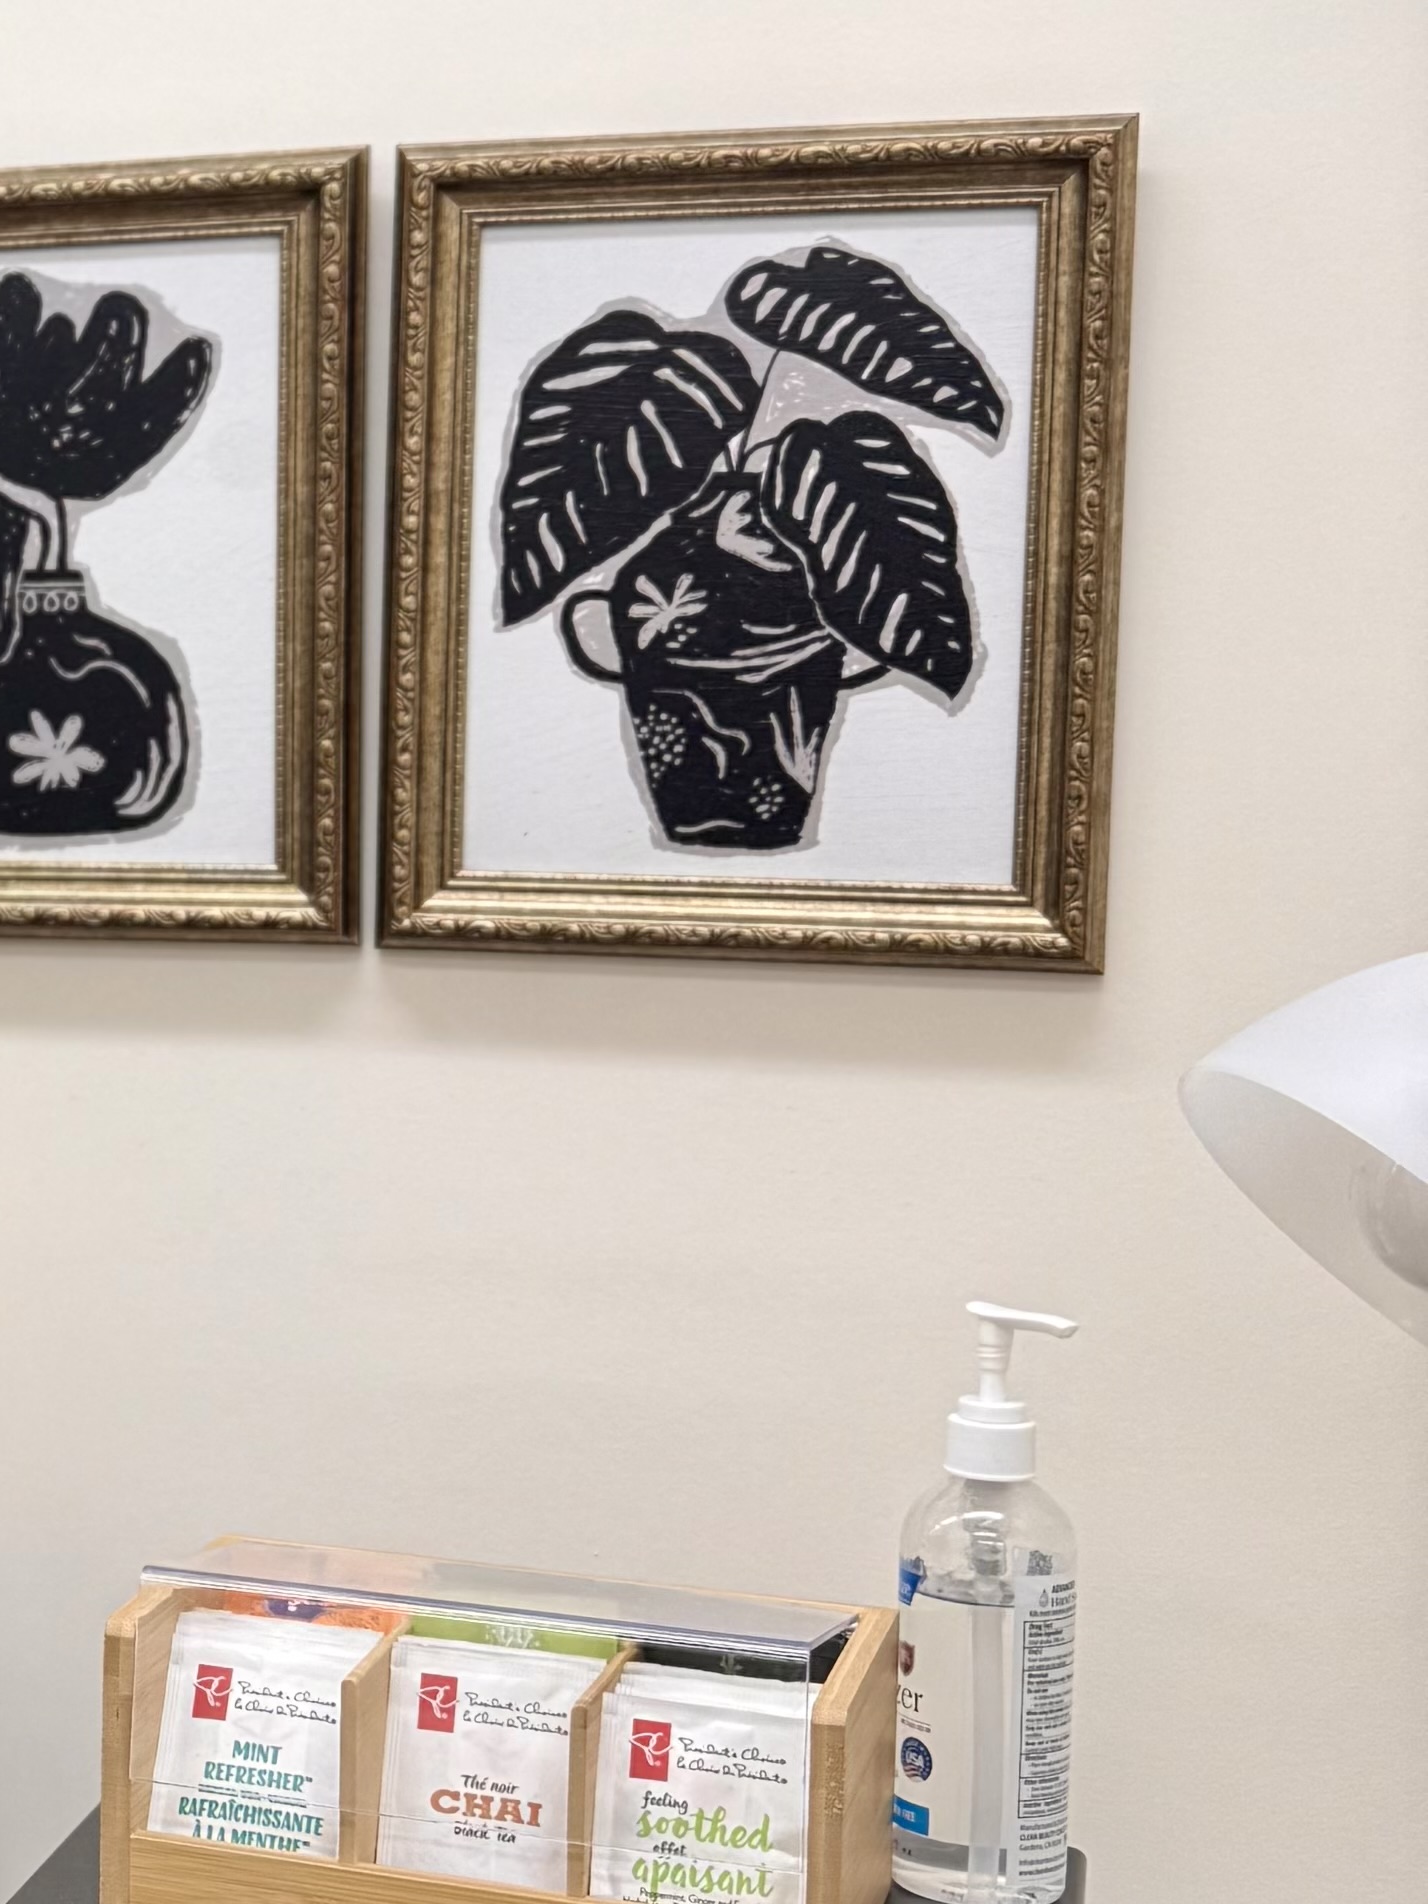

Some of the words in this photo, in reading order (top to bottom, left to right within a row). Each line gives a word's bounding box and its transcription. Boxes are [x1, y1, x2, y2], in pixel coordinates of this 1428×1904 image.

[232, 1740, 283, 1765] MINT
[461, 1774, 489, 1791] Thé
[491, 1781, 520, 1795] noir
[641, 1790, 689, 1815] feeling
[178, 1797, 325, 1837] RAFRAÎCHISSANTE
[430, 1788, 543, 1828] CHAI
[635, 1806, 775, 1853] soothed
[632, 1857, 775, 1900] apaisant
